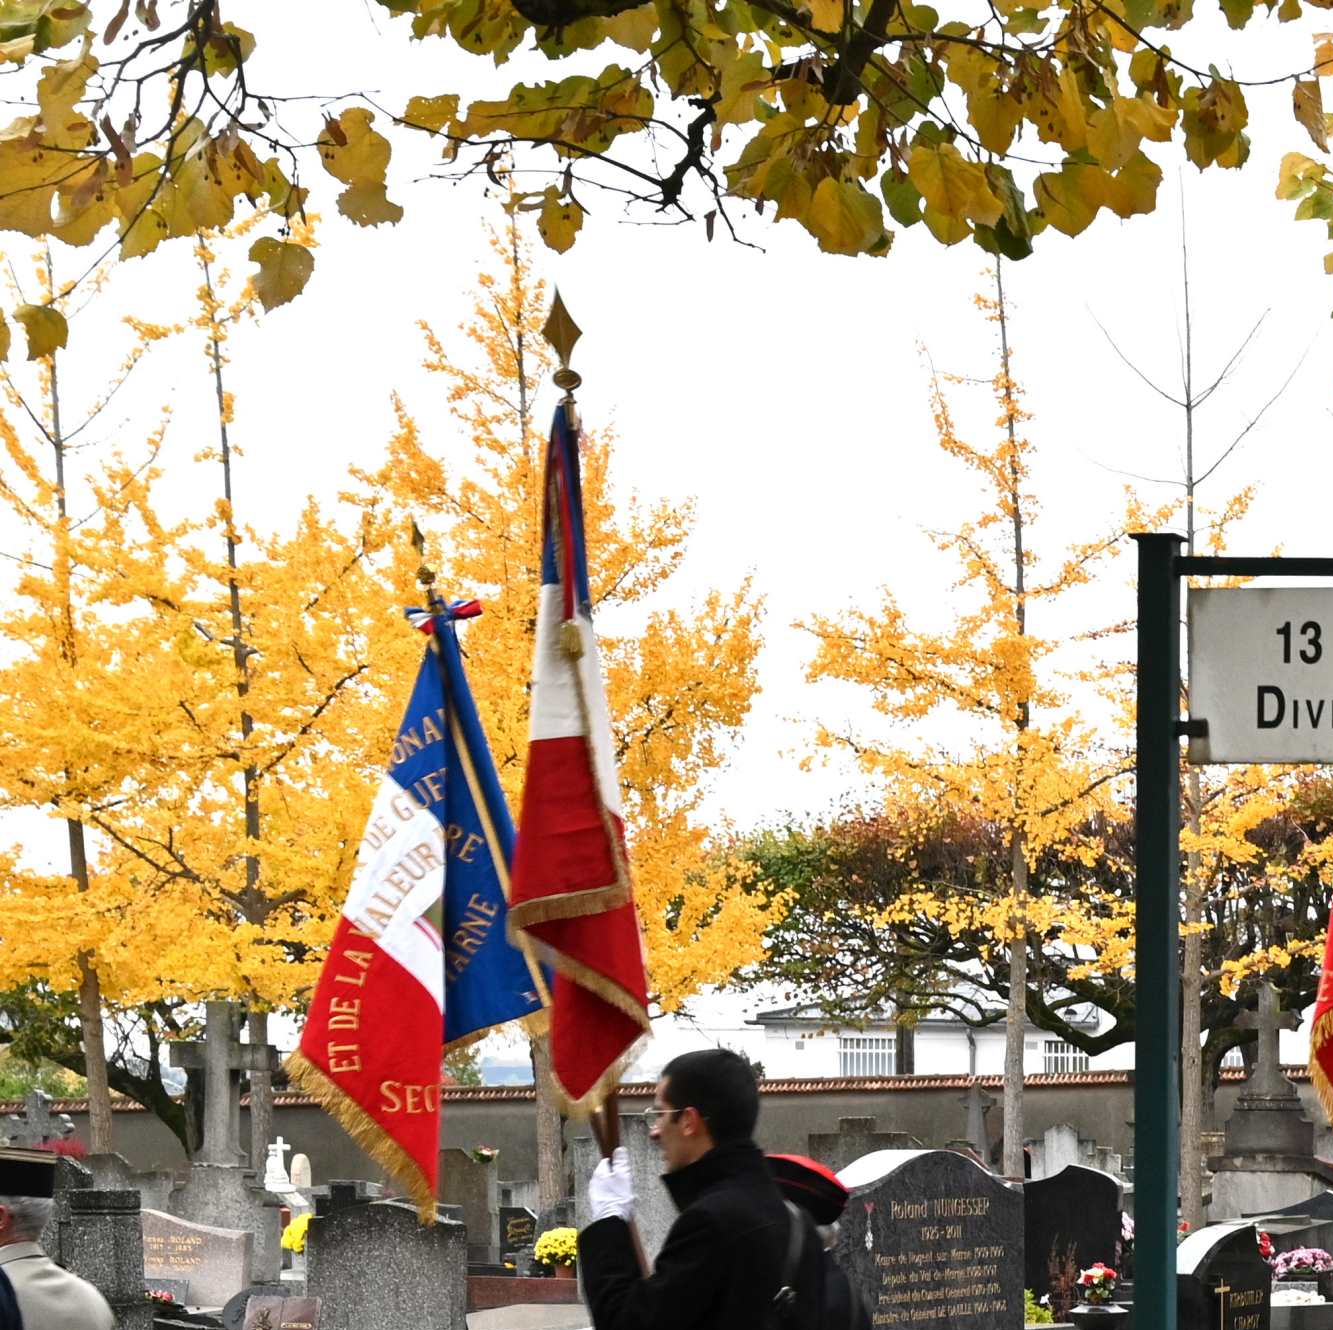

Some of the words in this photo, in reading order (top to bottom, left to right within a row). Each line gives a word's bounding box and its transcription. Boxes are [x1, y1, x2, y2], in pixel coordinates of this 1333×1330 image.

[1276, 620, 1322, 665] 13
[334, 947, 375, 988] LA
[327, 996, 361, 1031] DE
[327, 1041, 362, 1074] ET
